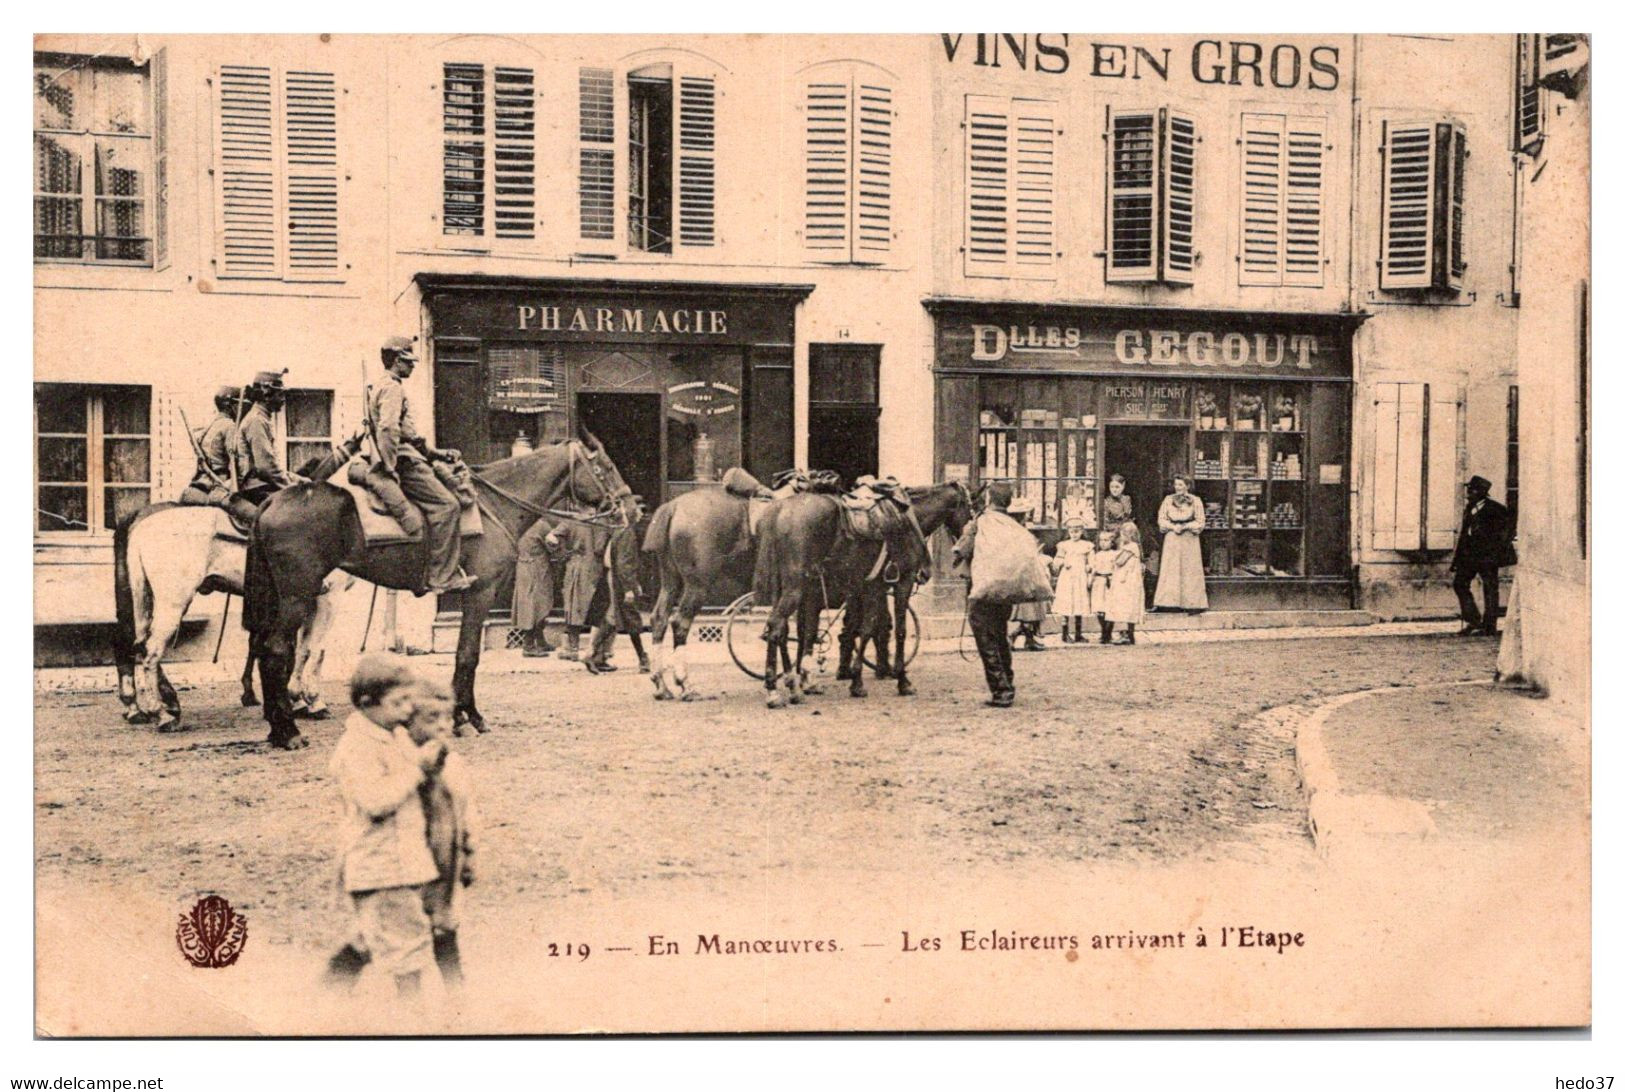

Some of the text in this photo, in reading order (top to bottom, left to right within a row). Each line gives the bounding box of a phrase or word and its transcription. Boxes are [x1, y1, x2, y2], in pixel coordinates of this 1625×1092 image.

[939, 33, 1340, 92] VINS EN GROS
[518, 306, 728, 334] PHARMACIE
[1104, 386, 1187, 399] PIERSON HENRY
